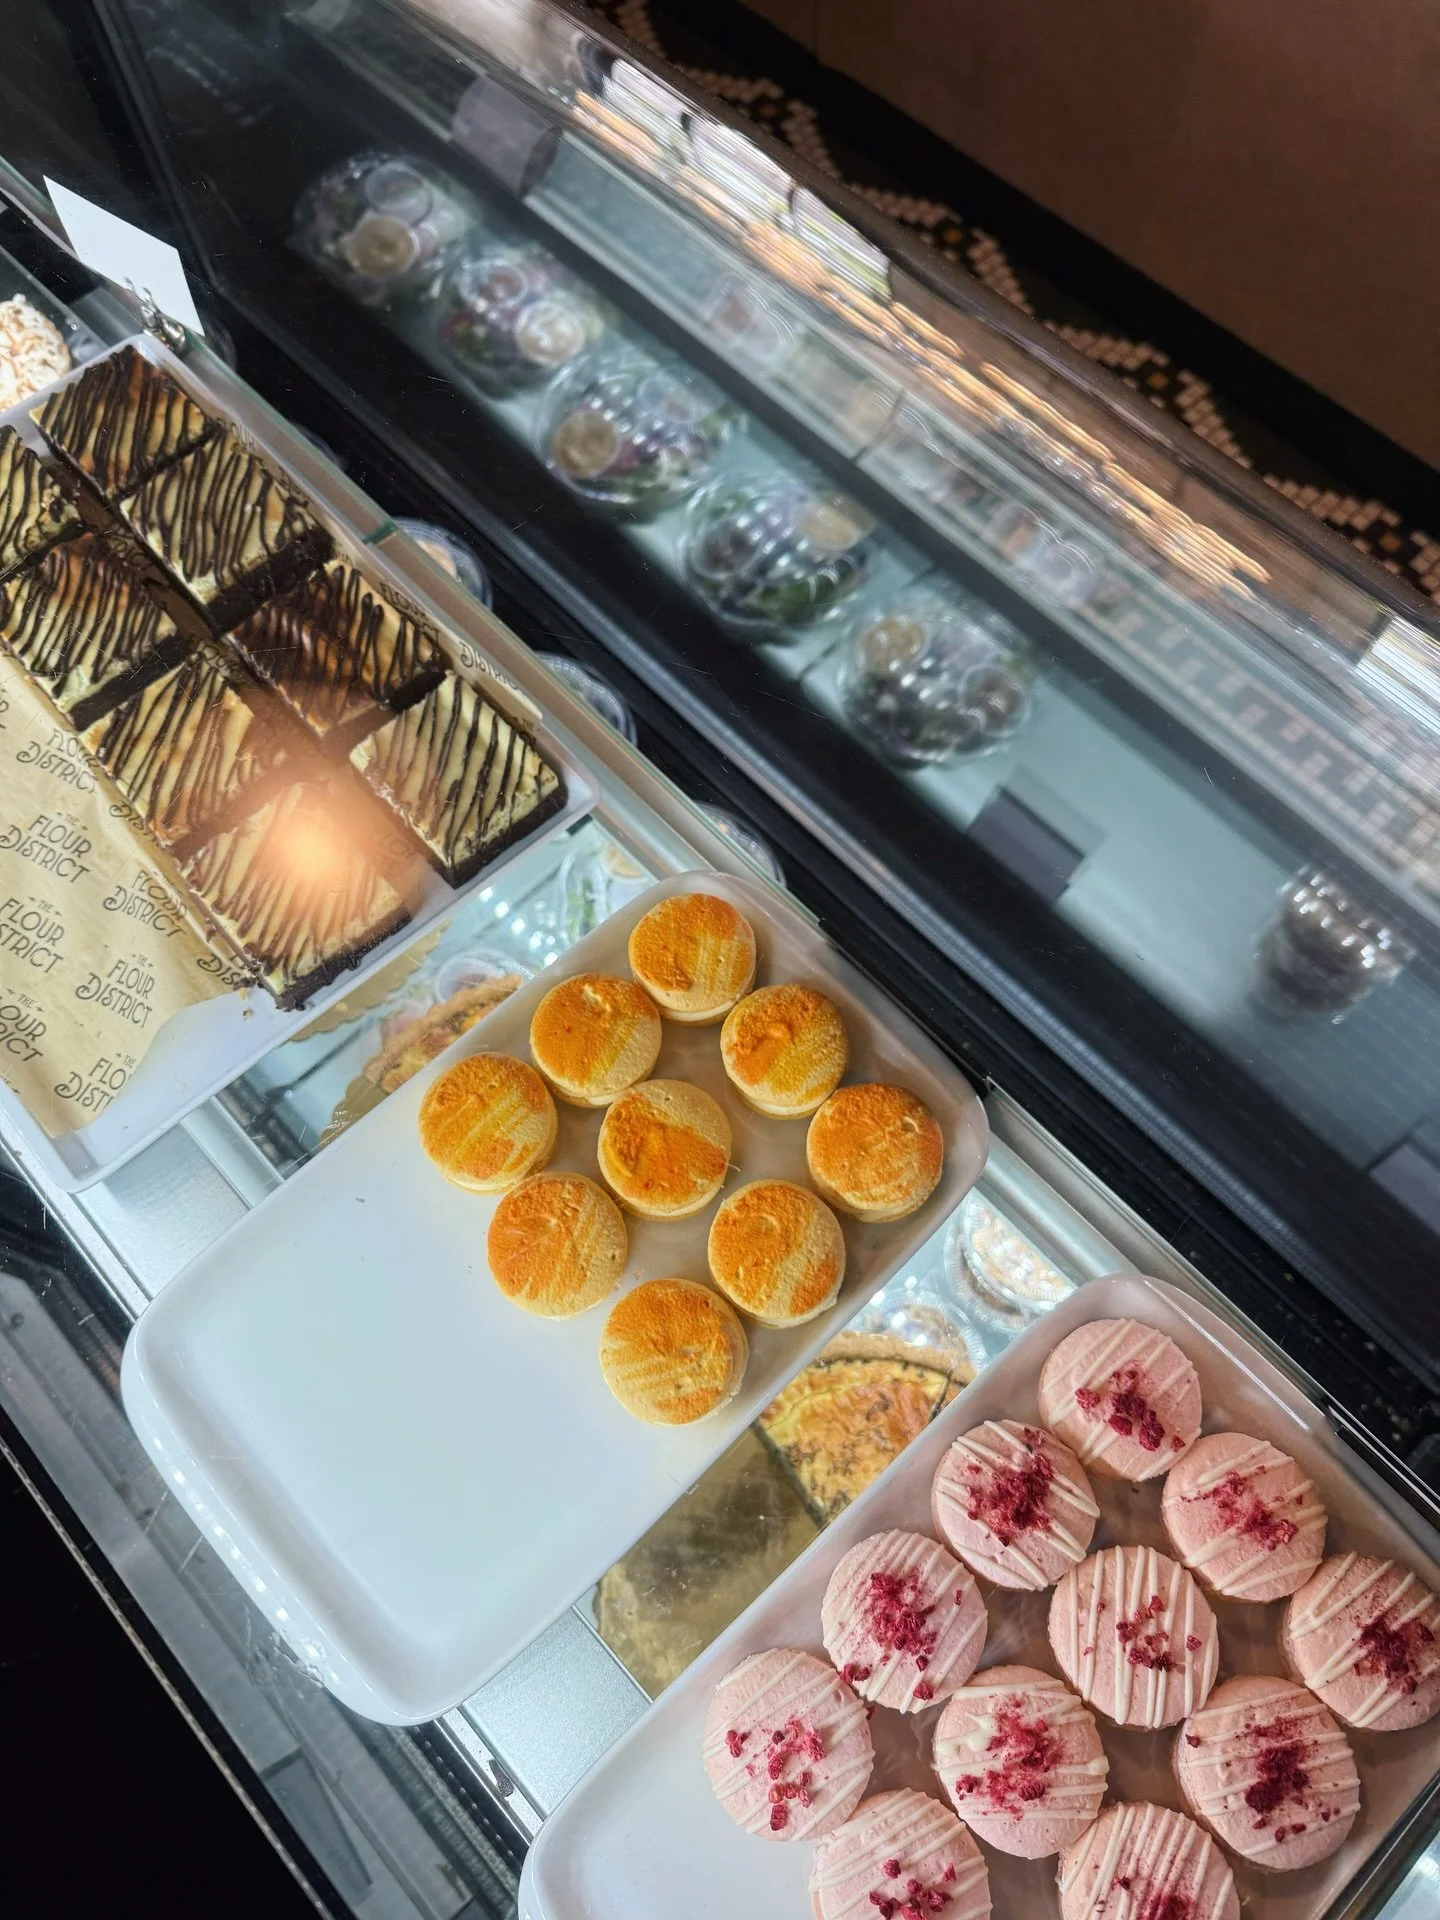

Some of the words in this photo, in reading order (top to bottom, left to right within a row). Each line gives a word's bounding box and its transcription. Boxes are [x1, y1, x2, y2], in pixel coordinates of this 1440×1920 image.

[16, 740, 99, 794] DISTRICT
[28, 814, 92, 859] FLOUR
[64, 813, 81, 827] THE
[0, 824, 90, 883] DISTRICT
[0, 897, 65, 947] FLOUR
[38, 899, 54, 913] THE
[102, 885, 187, 937] DISTRICT
[107, 958, 156, 999] FLOUR
[18, 992, 36, 1009] THE
[75, 972, 153, 1029] DISTRICT
[0, 1005, 47, 1042] OUR
[88, 1056, 133, 1090] FLO
[124, 1054, 137, 1069] THE
